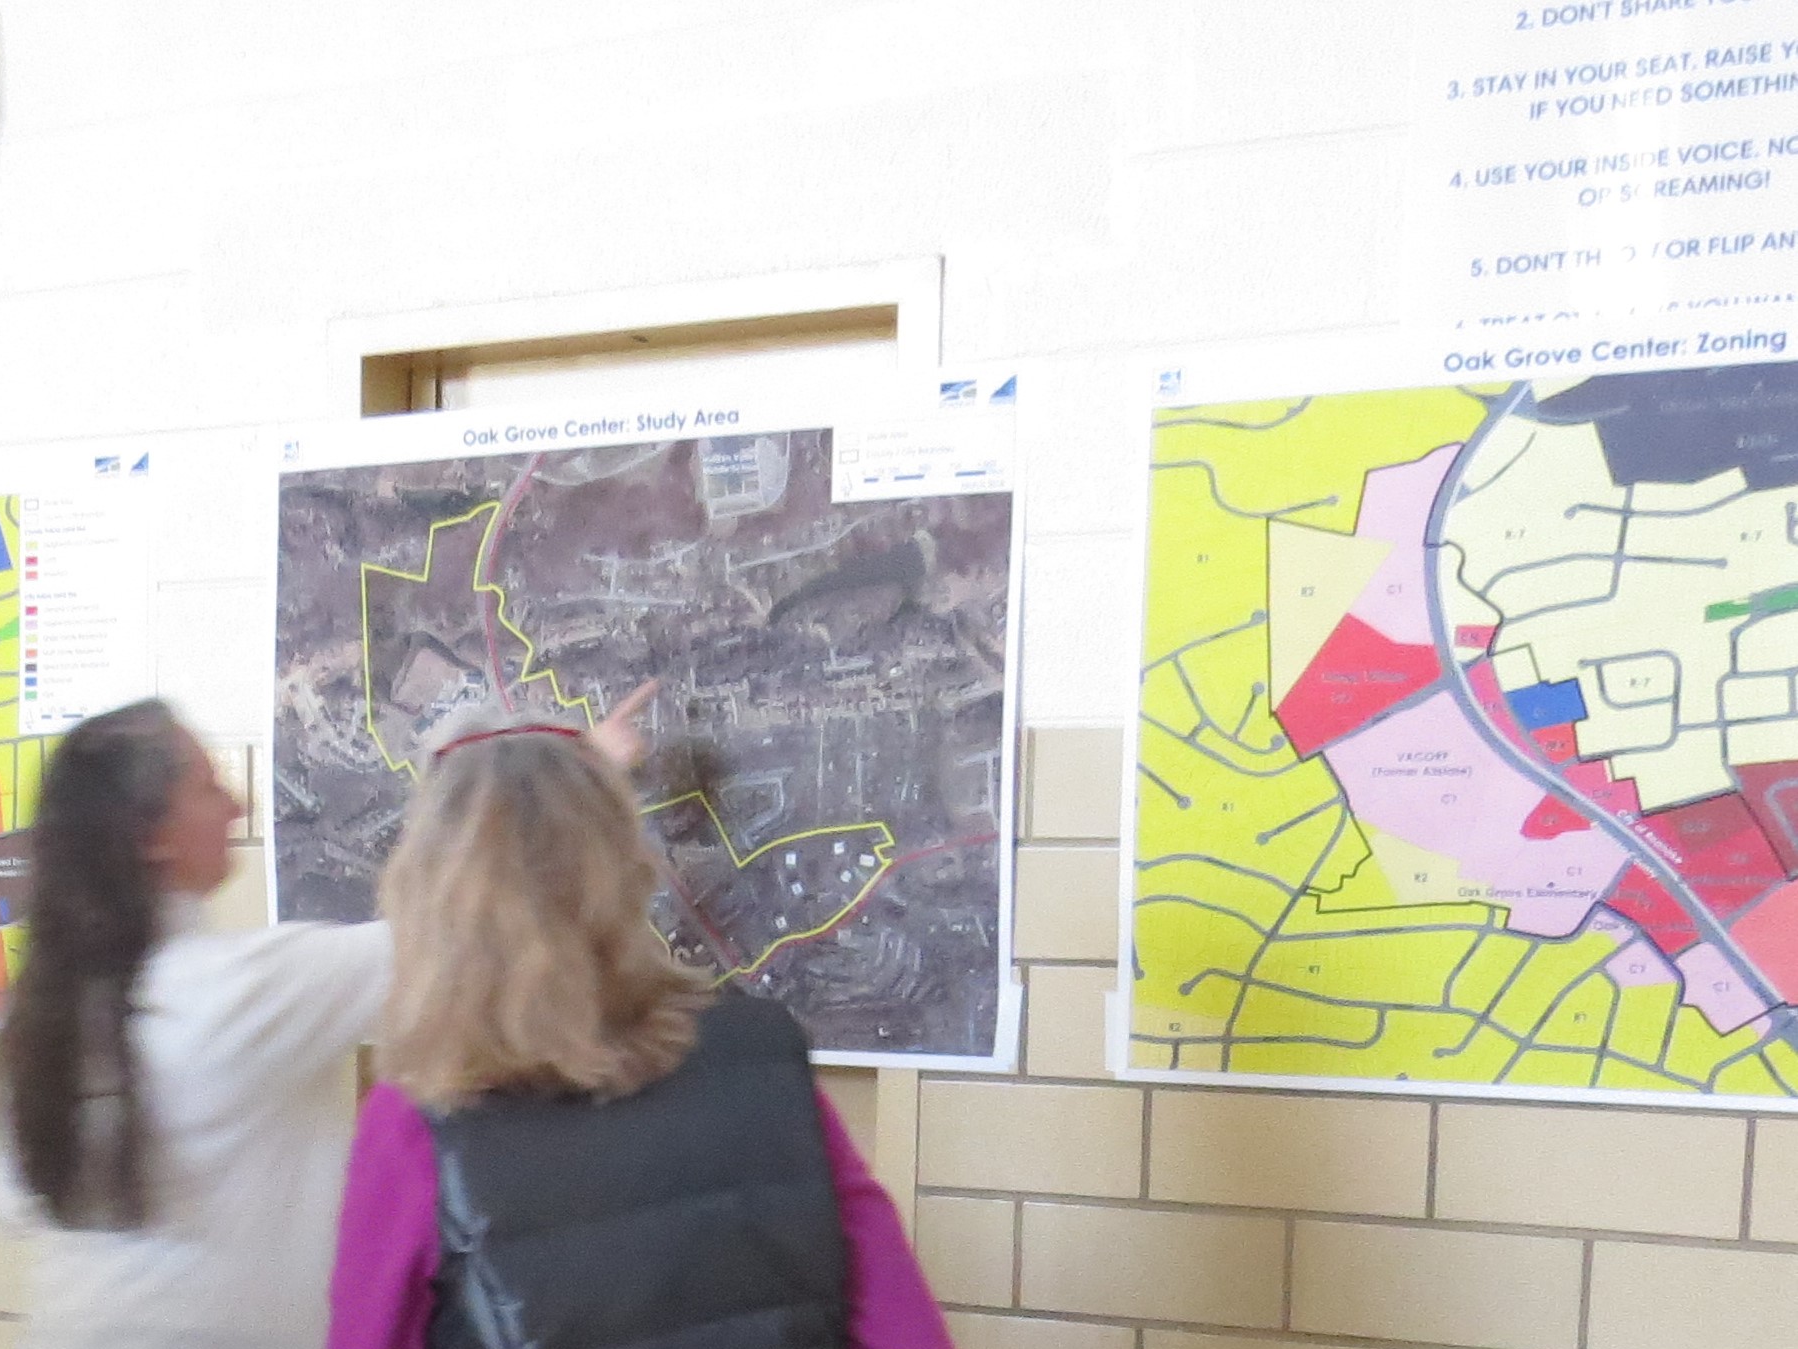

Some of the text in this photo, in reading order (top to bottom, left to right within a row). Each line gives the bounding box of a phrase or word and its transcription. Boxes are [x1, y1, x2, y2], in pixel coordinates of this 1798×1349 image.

[1516, 11, 1533, 31] 2.
[1542, 1, 1611, 28] DON'T
[1447, 80, 1465, 101] 3.
[1472, 72, 1527, 98] STAY
[1534, 69, 1557, 90] IN
[1564, 62, 1627, 86] YOUR
[1635, 51, 1699, 78] SEAT.
[1704, 42, 1772, 70] RAISE
[1529, 72, 1798, 121] IF YOU NEED SOMETHIN
[1448, 171, 1467, 190] 4.
[1475, 163, 1517, 187] USE
[1525, 158, 1588, 183] YOUR
[1594, 147, 1670, 175] INSIDE
[1677, 138, 1760, 165] VOICE.
[1470, 257, 1489, 279] 5.
[1495, 250, 1566, 277] DON'T
[1665, 237, 1700, 260] OR
[1707, 230, 1755, 256] FLIP
[1443, 328, 1788, 374] Oak Grove Center: Zoning
[462, 408, 740, 447] Oak Grove Center: Study Area
